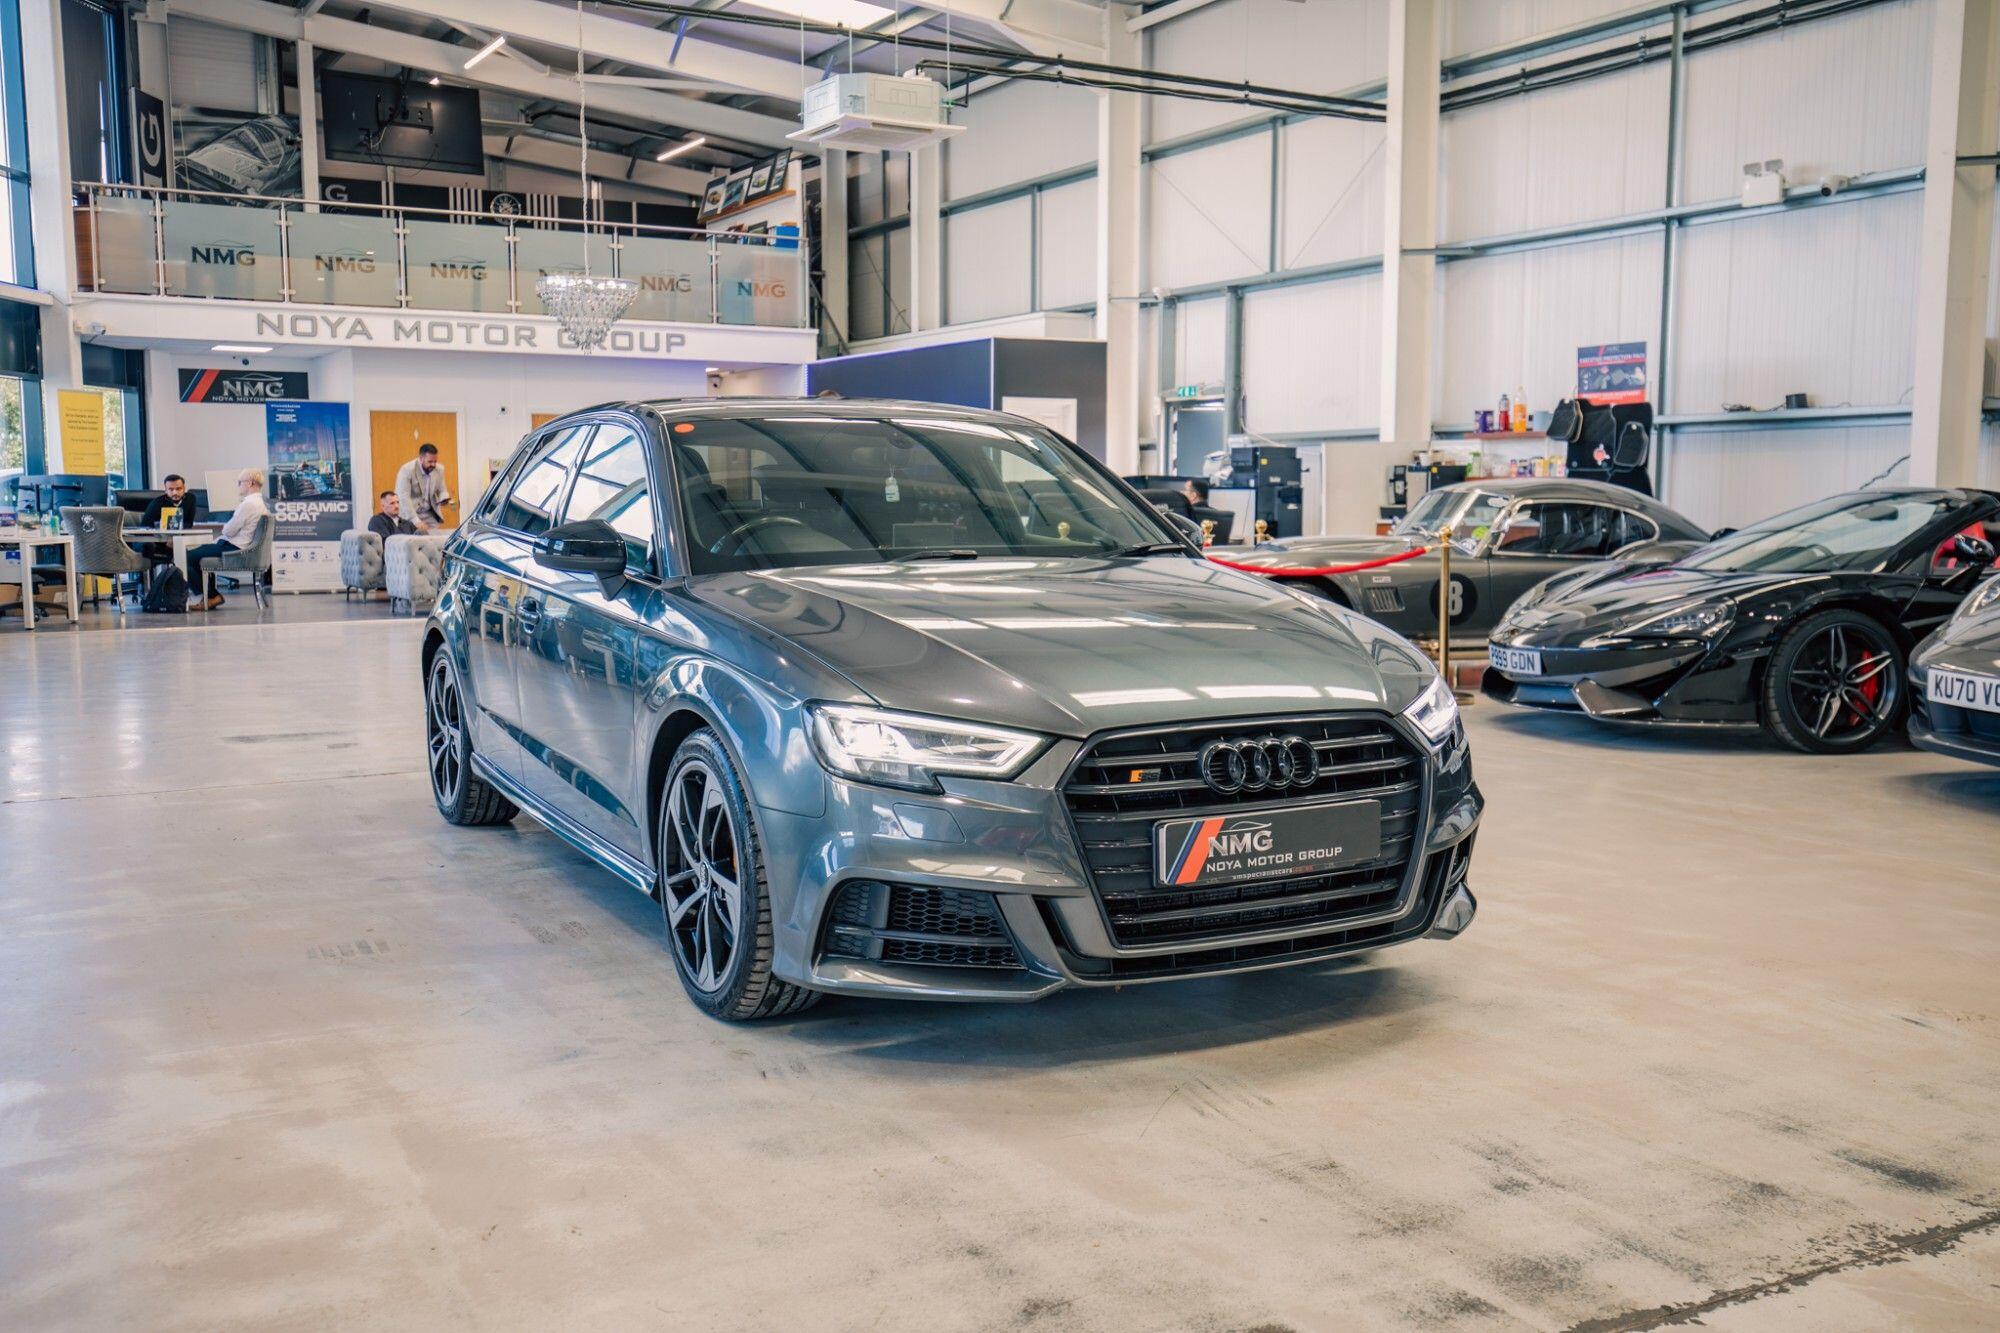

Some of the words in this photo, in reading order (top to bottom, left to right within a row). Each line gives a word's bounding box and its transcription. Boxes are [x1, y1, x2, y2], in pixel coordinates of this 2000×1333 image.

[191, 246, 256, 267] NMG
[315, 254, 376, 274] NMG
[430, 262, 487, 281] NMG
[640, 275, 692, 293] NMG
[737, 281, 786, 298] NMG
[257, 312, 373, 341] NOYA
[394, 319, 537, 348] MOTOR
[557, 328, 686, 353] GOUP
[222, 380, 285, 397] NMG
[275, 502, 349, 513] CERAMIC
[275, 512, 320, 522] COAT
[1510, 651, 1535, 672] GDN
[1934, 674, 1976, 703] KU70
[1208, 830, 1274, 859] NMG
[1206, 860, 1242, 873] NOYA
[1247, 852, 1293, 868] MOTOR
[1298, 846, 1343, 861] GROUP
